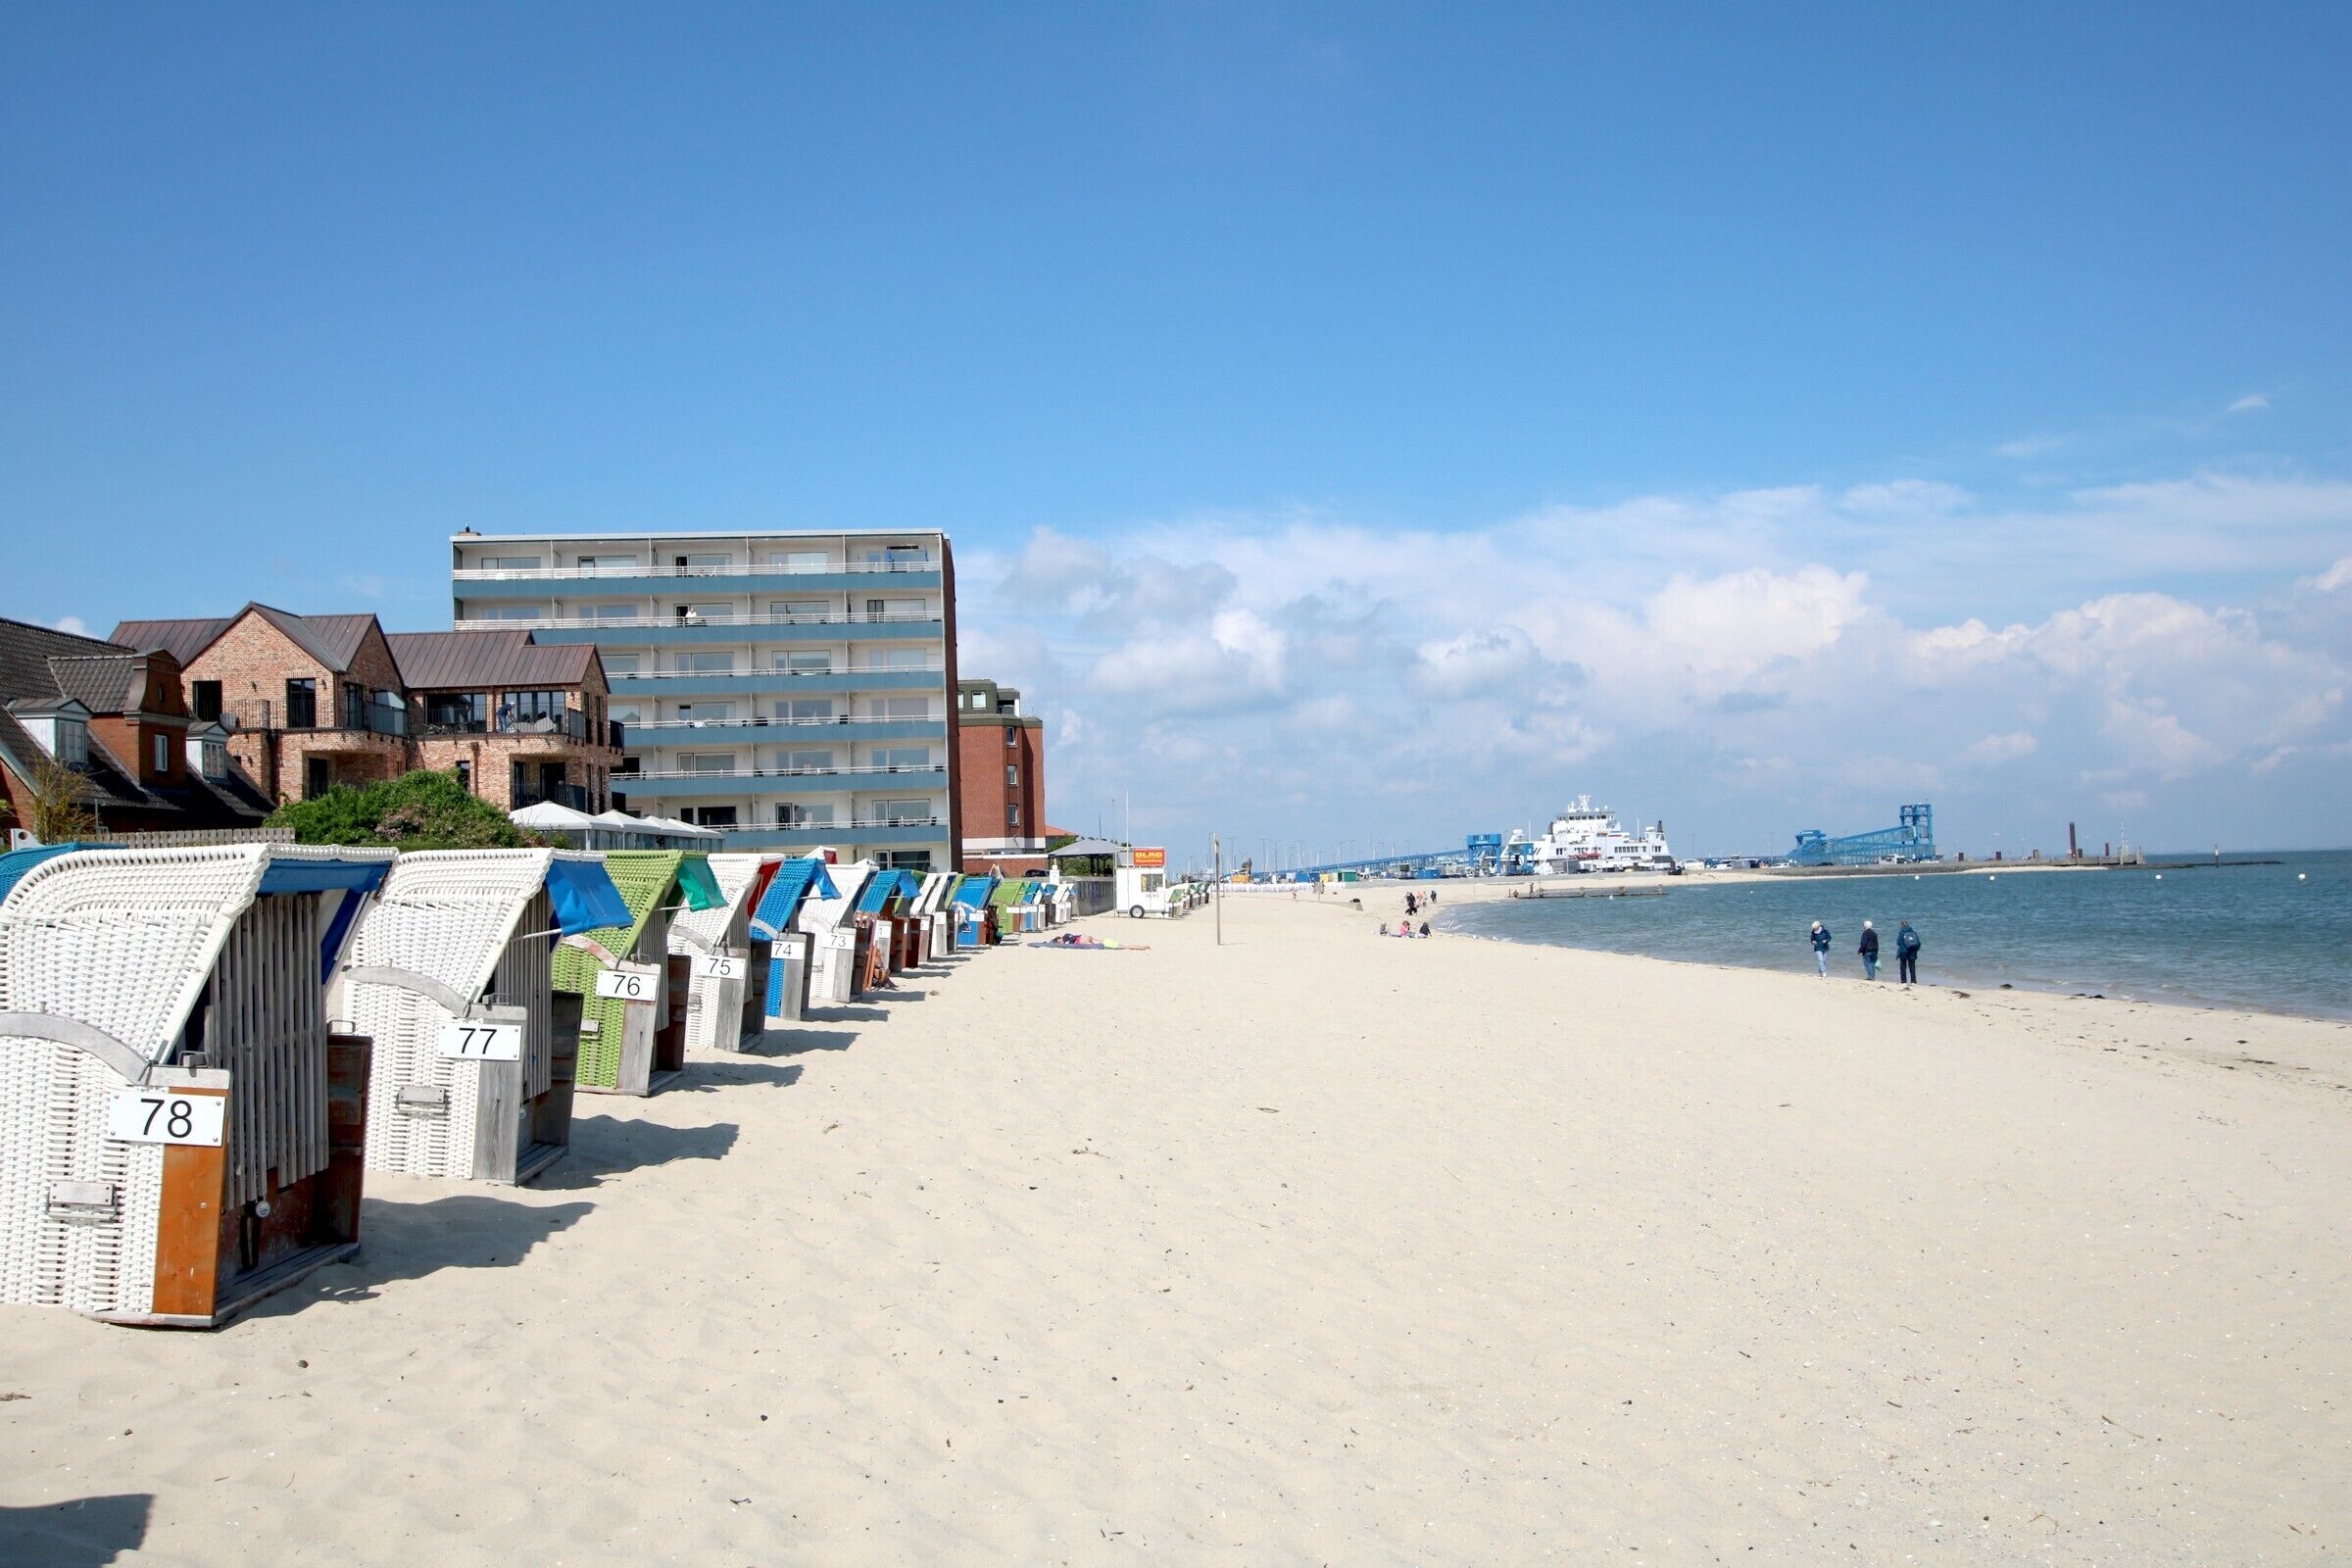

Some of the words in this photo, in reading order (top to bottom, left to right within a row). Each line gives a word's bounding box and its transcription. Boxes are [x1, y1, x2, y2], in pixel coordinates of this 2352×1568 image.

[774, 943, 792, 956] 74
[830, 934, 847, 948] 73
[709, 957, 731, 976] 75
[613, 974, 641, 997] 76
[459, 1027, 498, 1055] 77
[140, 1098, 193, 1139] 78
